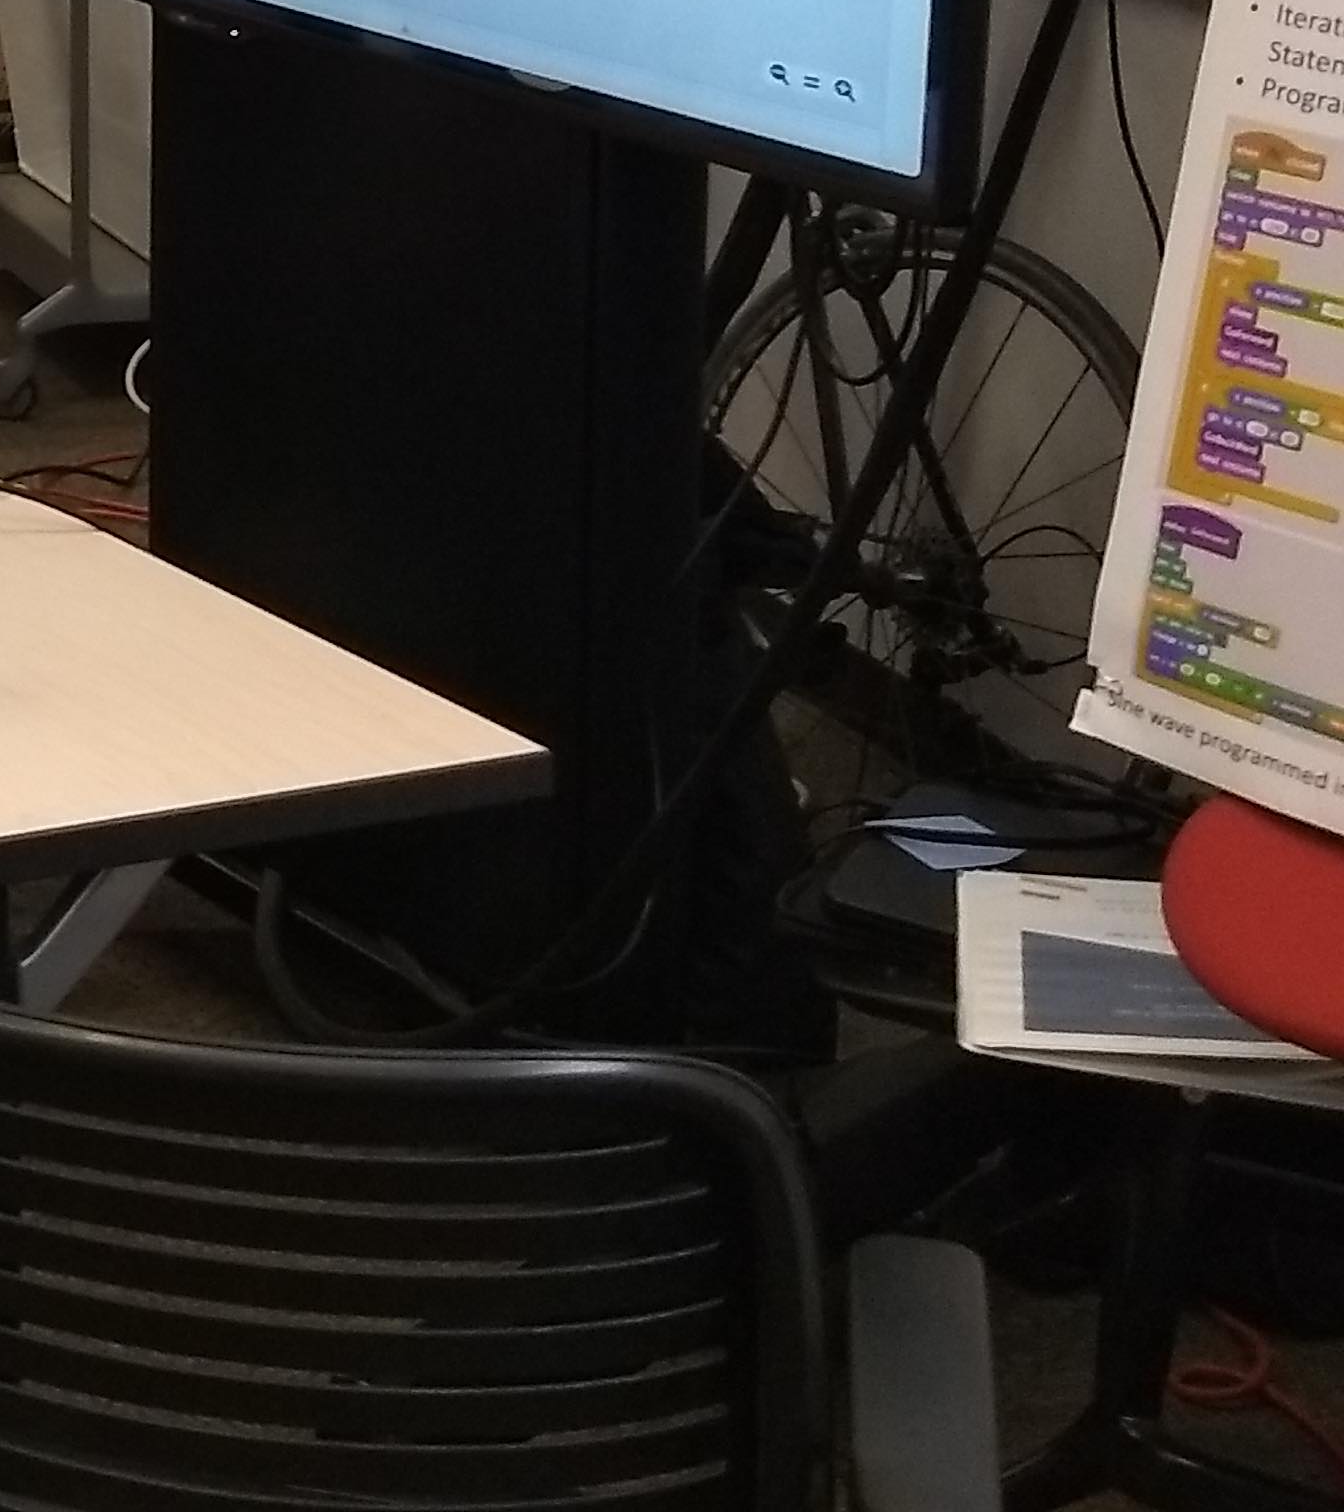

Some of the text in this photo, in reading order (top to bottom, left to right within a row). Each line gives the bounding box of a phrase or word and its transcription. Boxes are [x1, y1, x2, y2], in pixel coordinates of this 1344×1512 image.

[1276, 3, 1344, 37] Iterat
[1261, 77, 1344, 114] Progra
[1149, 711, 1196, 739] wave
[1199, 730, 1329, 790] programmed
